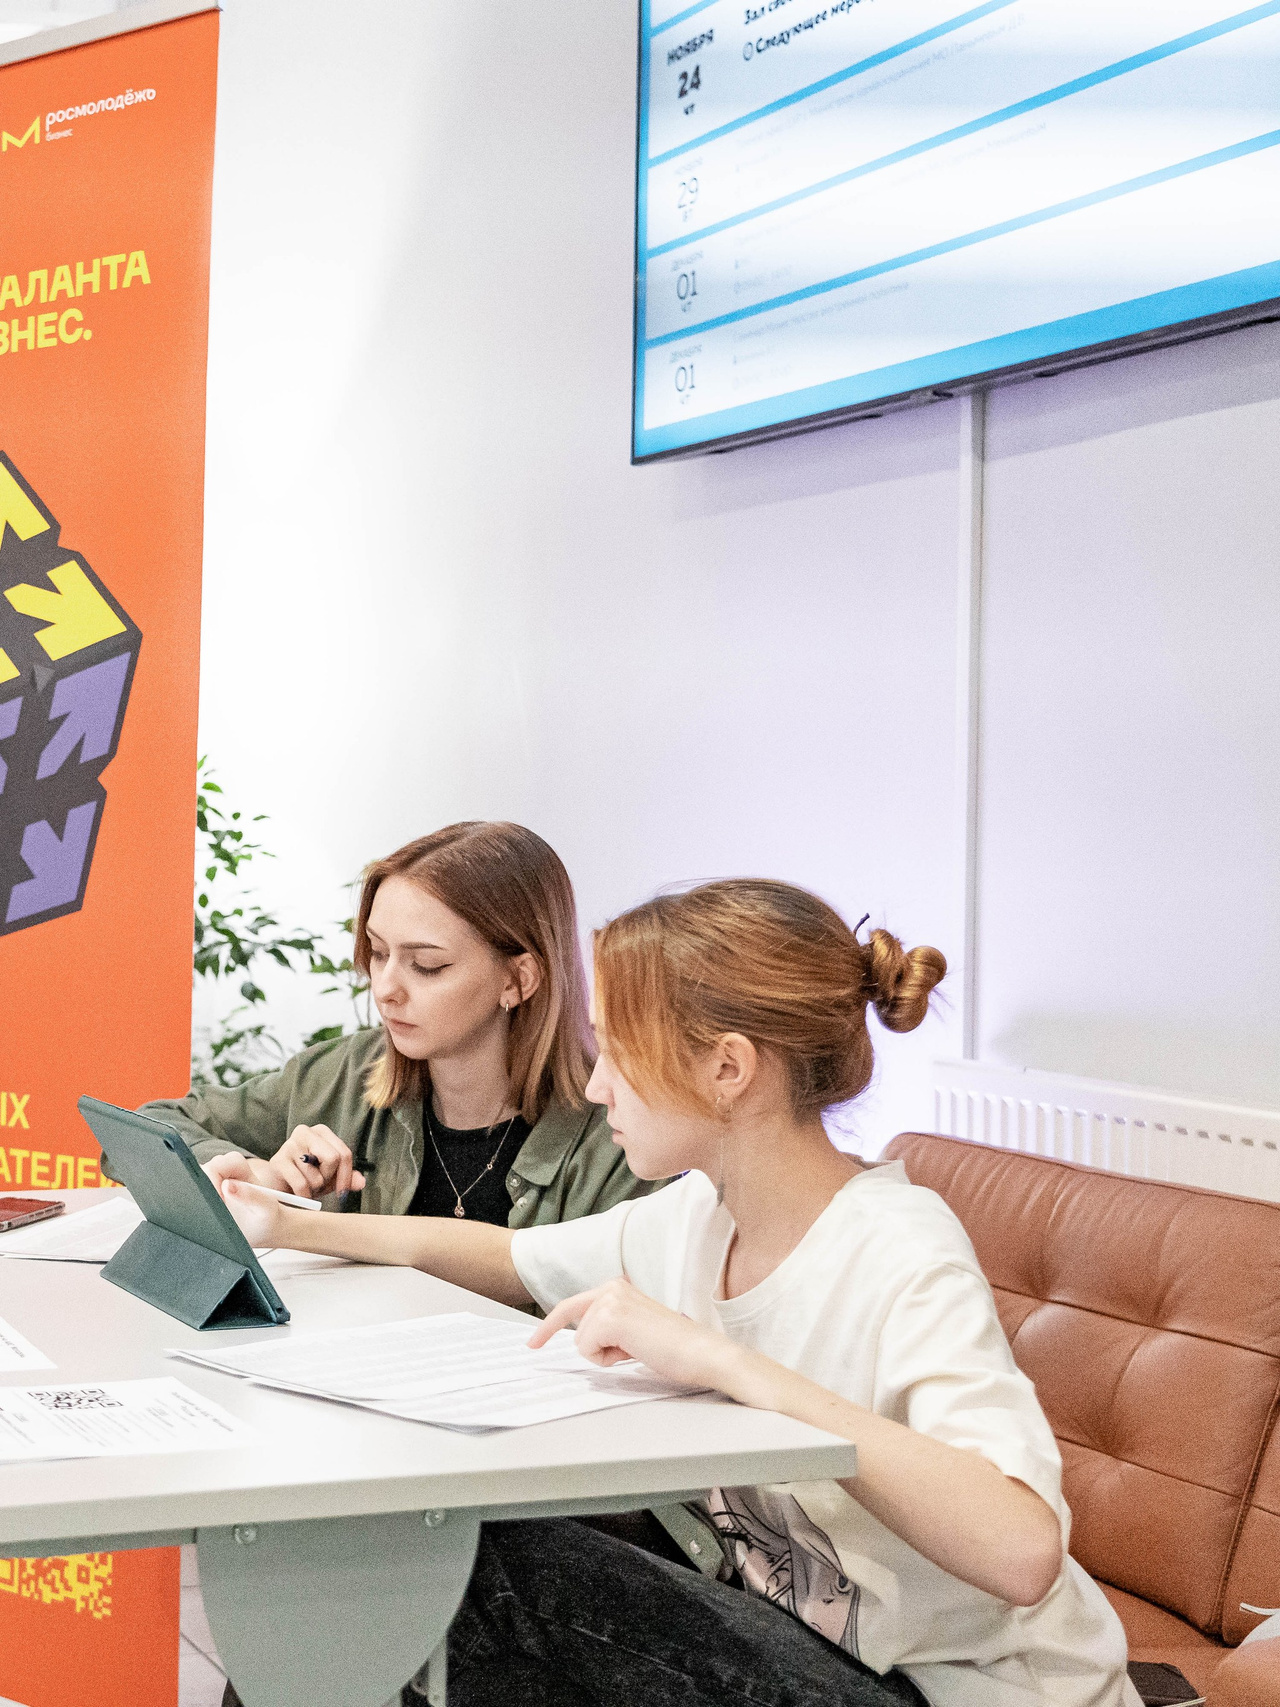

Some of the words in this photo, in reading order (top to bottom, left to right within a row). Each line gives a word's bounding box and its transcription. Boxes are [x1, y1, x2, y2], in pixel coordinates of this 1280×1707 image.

[755, 10, 828, 54] Следующее
[677, 64, 702, 99] 24
[677, 176, 699, 209] 29
[676, 270, 699, 301] 01
[674, 363, 696, 393] 01
